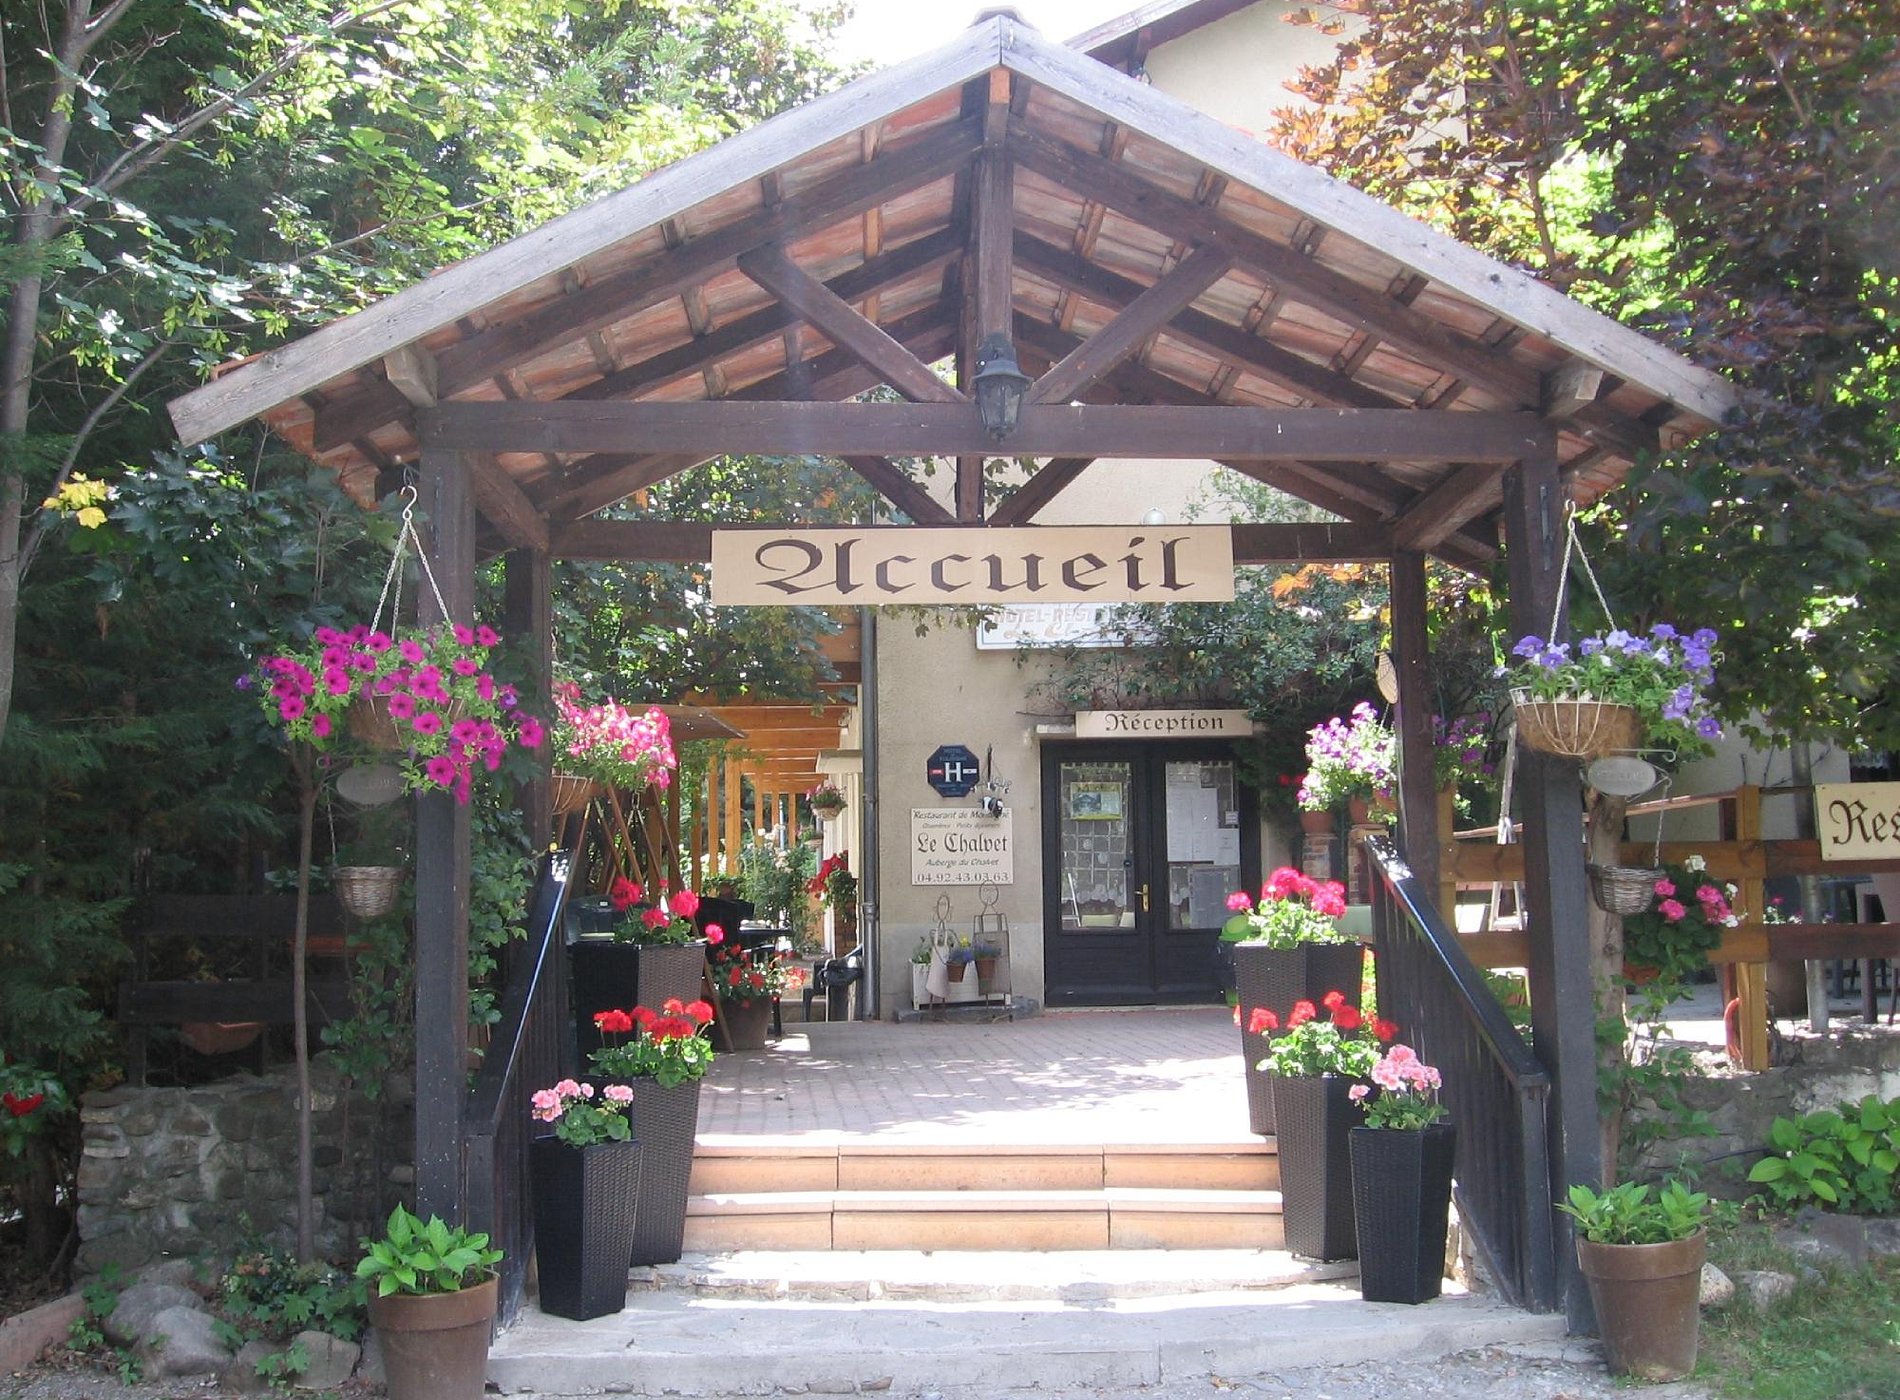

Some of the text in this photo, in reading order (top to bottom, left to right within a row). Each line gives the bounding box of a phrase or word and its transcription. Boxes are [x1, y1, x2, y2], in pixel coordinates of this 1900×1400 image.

[755, 536, 1196, 595] Accueil
[1104, 712, 1224, 734] Réception
[944, 762, 963, 783] H
[917, 832, 1008, 857] Le Chalvet
